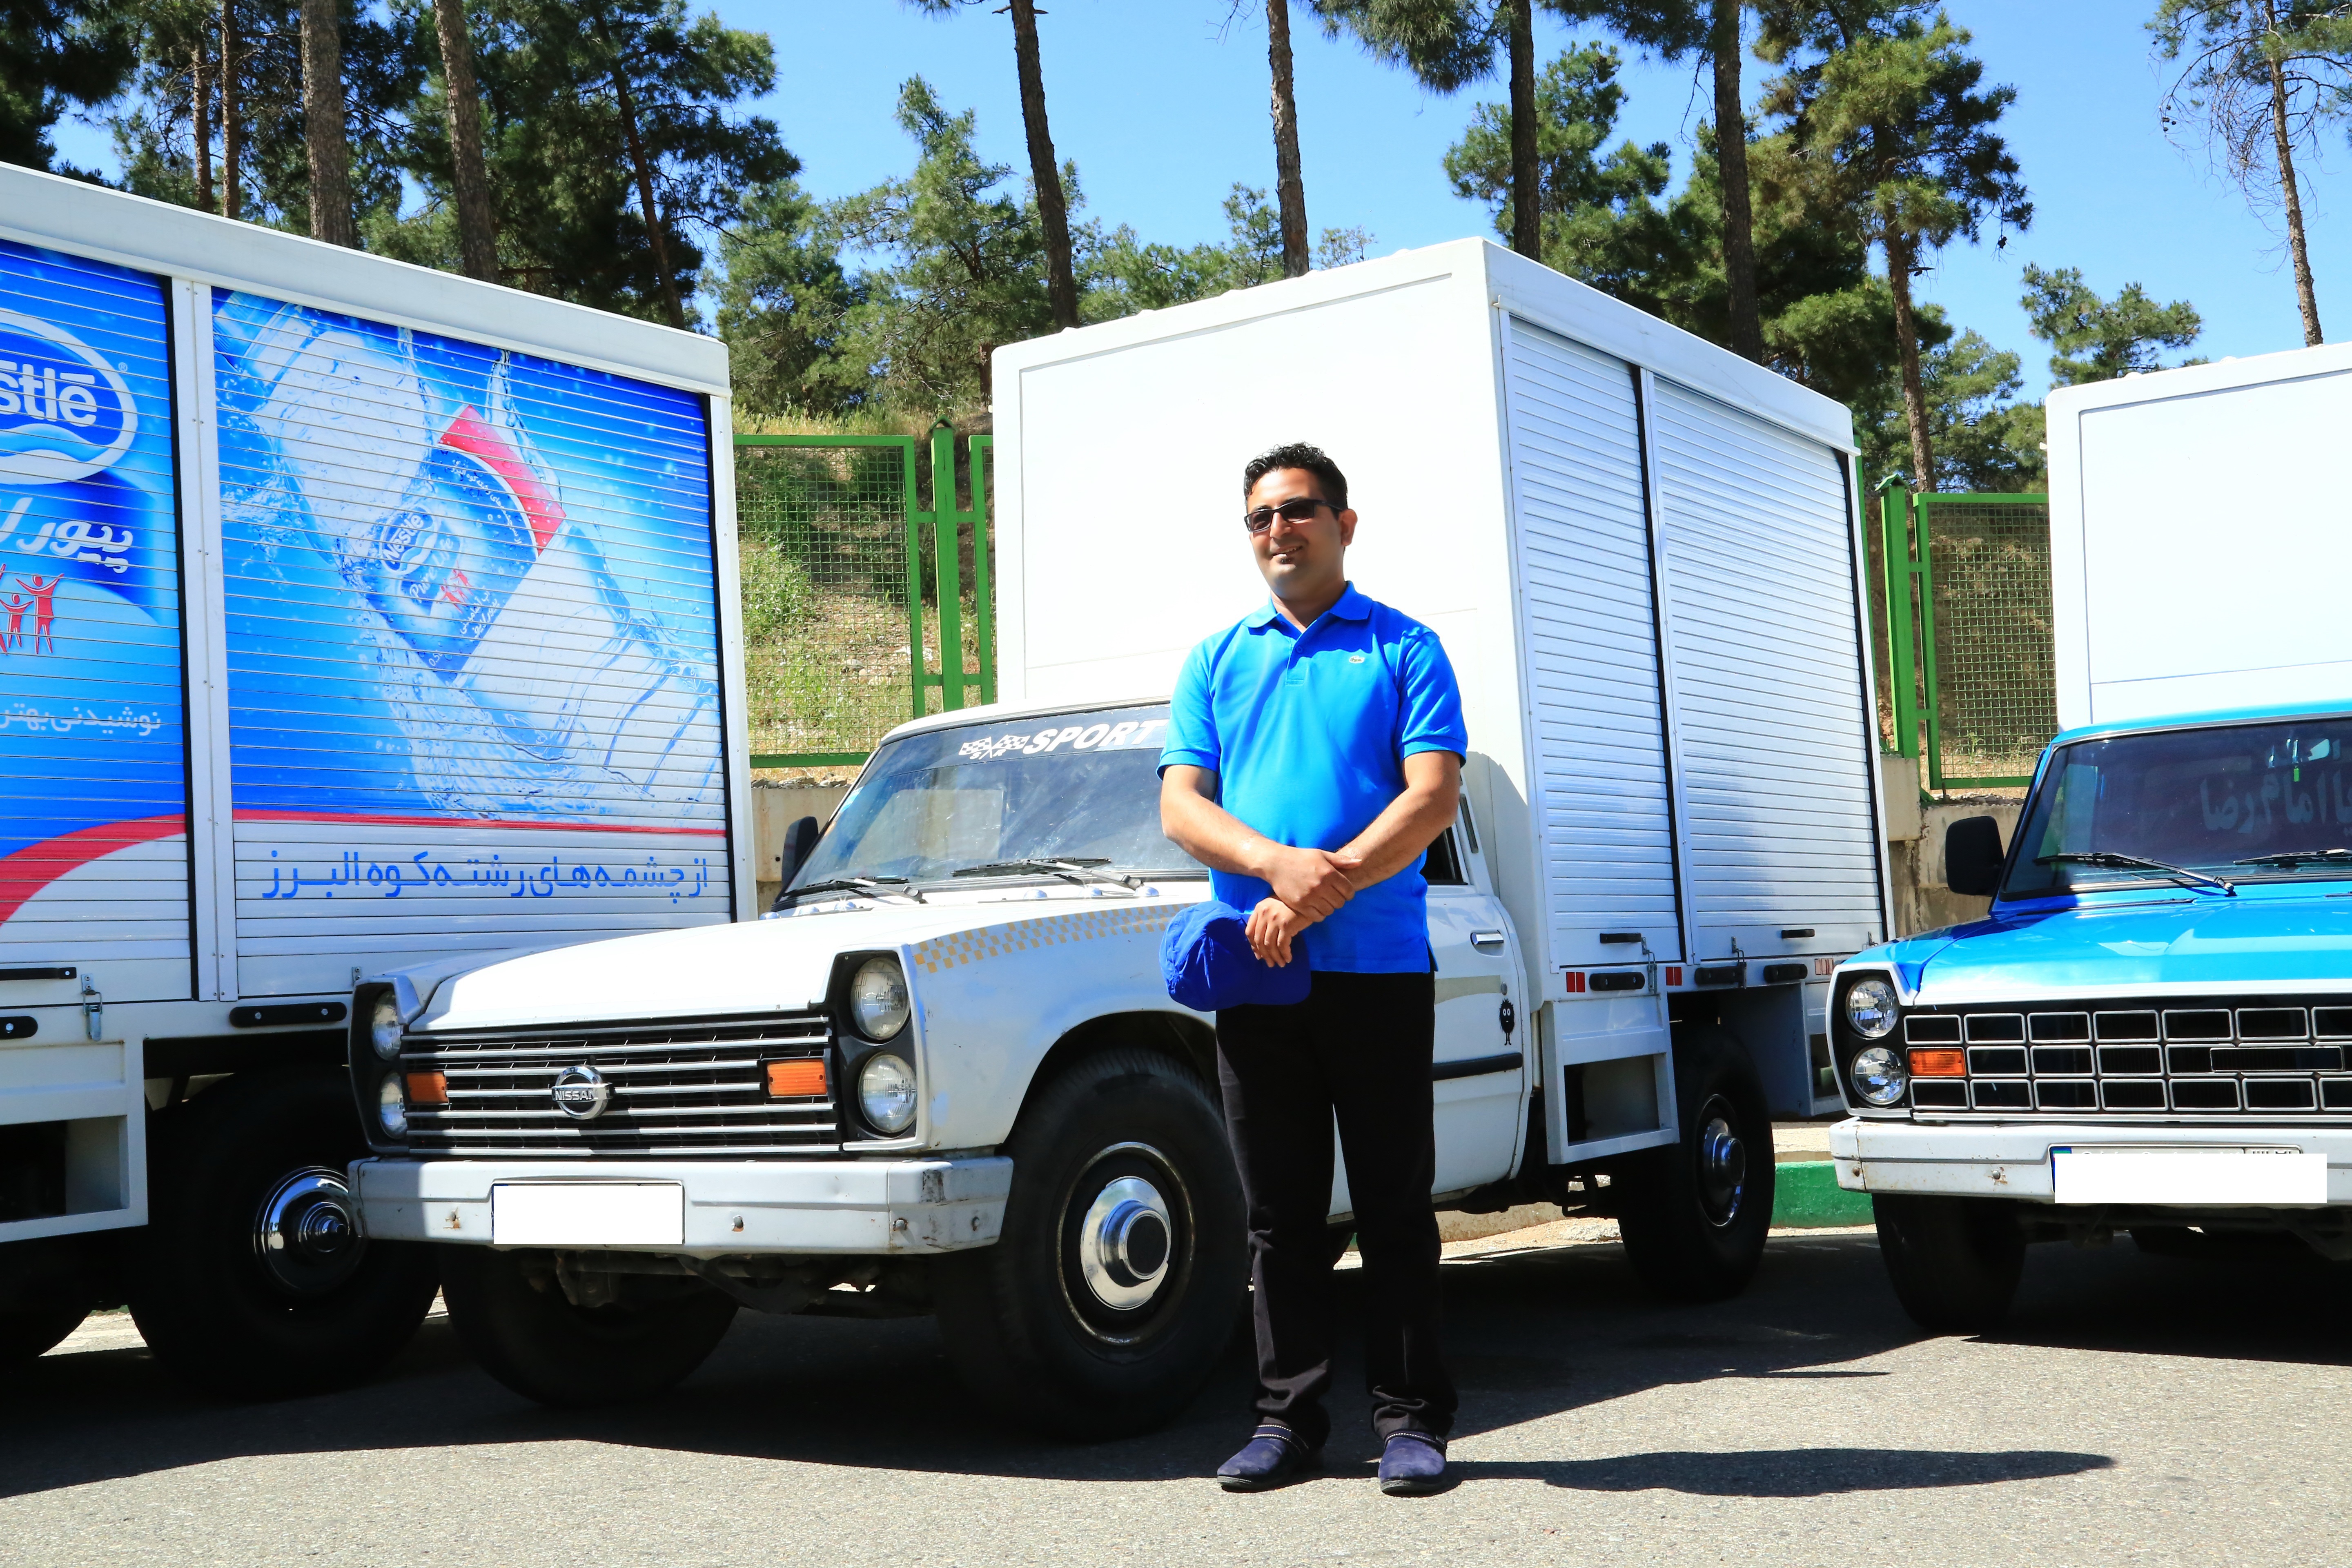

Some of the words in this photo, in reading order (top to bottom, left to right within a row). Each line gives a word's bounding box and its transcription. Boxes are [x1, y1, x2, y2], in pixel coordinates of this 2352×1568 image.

[409, 567, 437, 604] Pure
[431, 537, 454, 569] Life
[51, 706, 161, 736] نوشیدنی
[1022, 718, 1169, 755] SPORT
[262, 850, 360, 898] البرز
[368, 850, 430, 898] کوه
[433, 854, 525, 898] رشته
[688, 858, 708, 898] از
[555, 1090, 599, 1100] NISSAN
